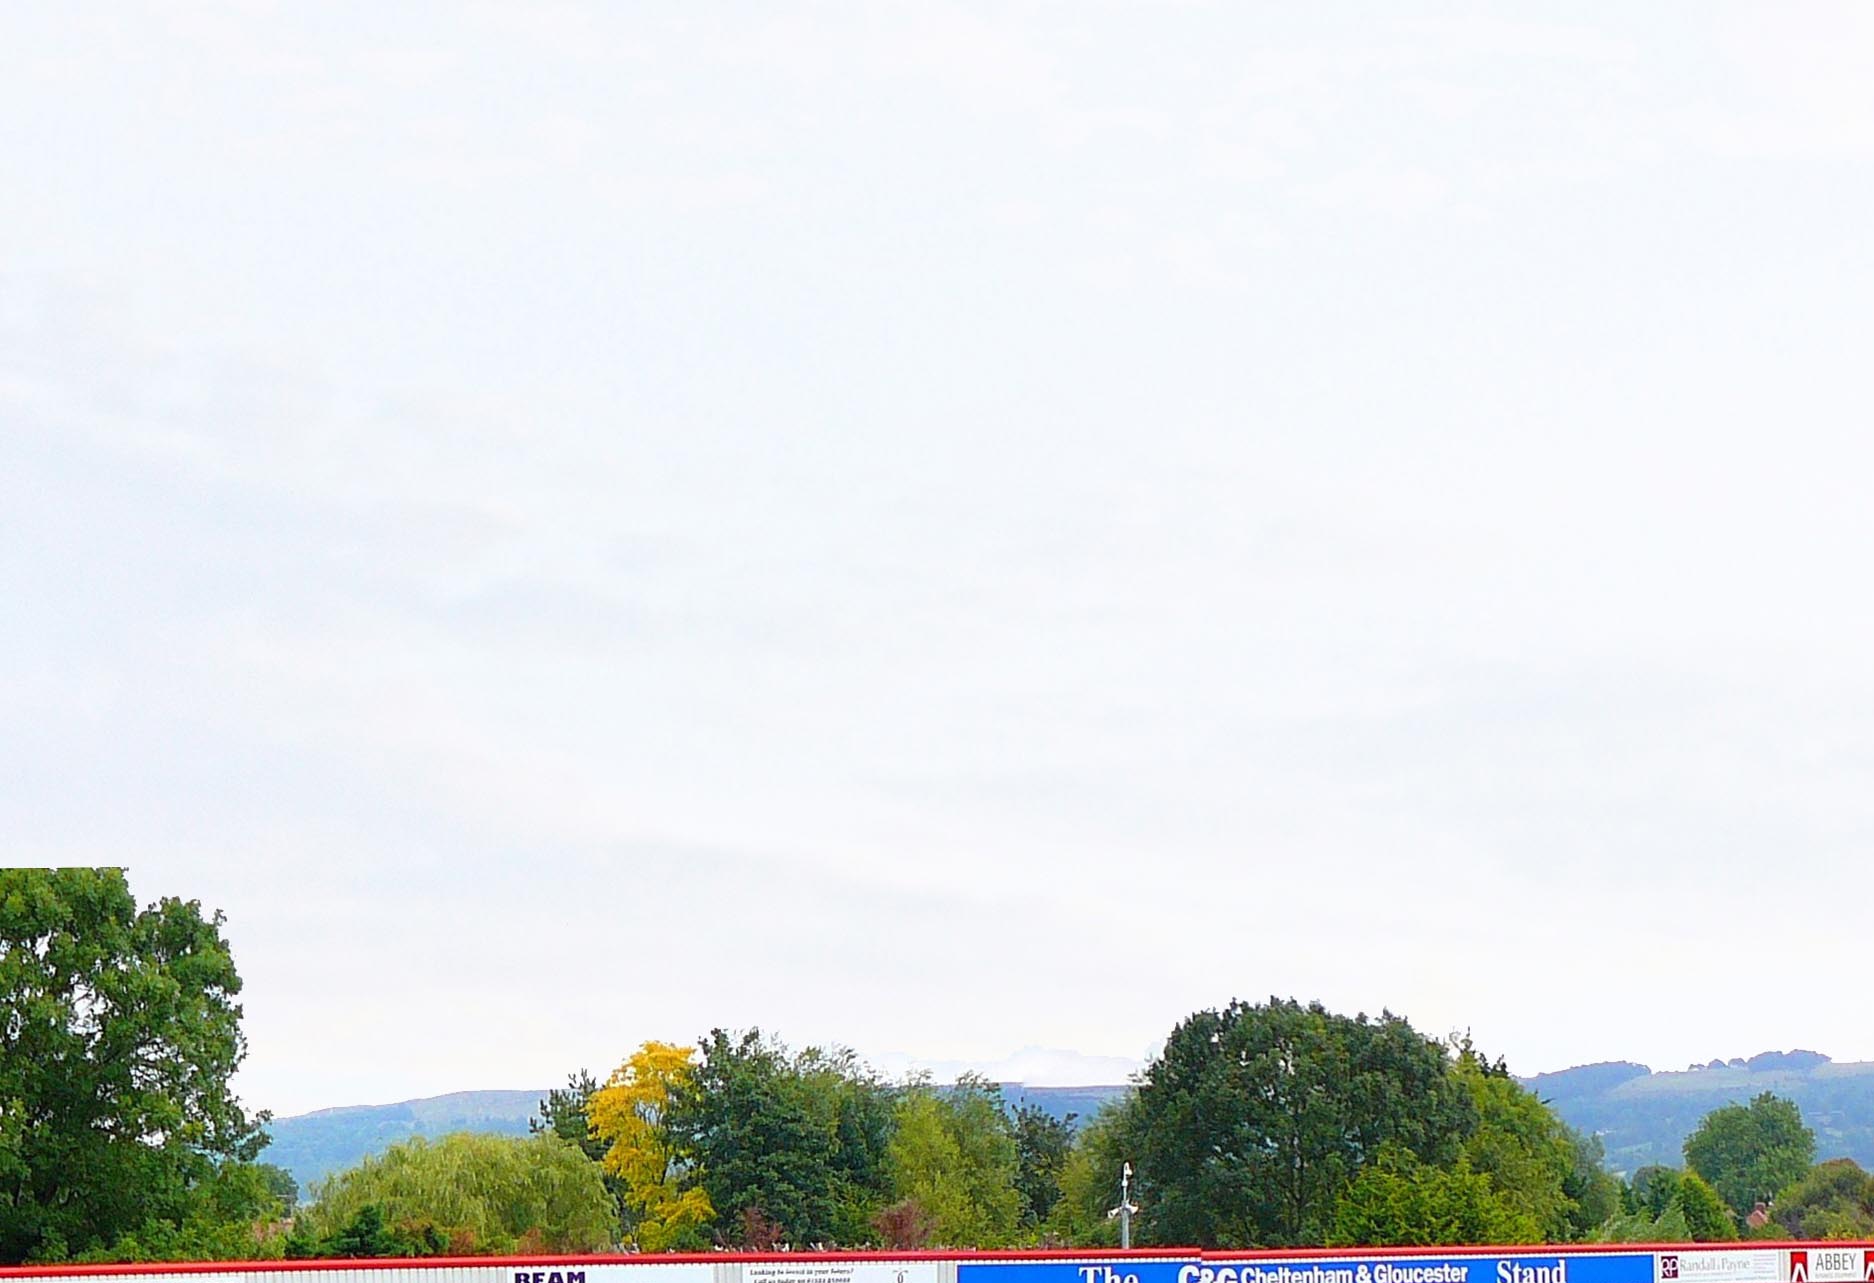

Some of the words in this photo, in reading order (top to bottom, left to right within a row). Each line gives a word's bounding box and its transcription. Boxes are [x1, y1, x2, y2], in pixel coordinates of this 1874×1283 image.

[1680, 1258, 1715, 1272] Randall
[1722, 1257, 1750, 1273] Payne
[1815, 1253, 1857, 1271] ABBEY
